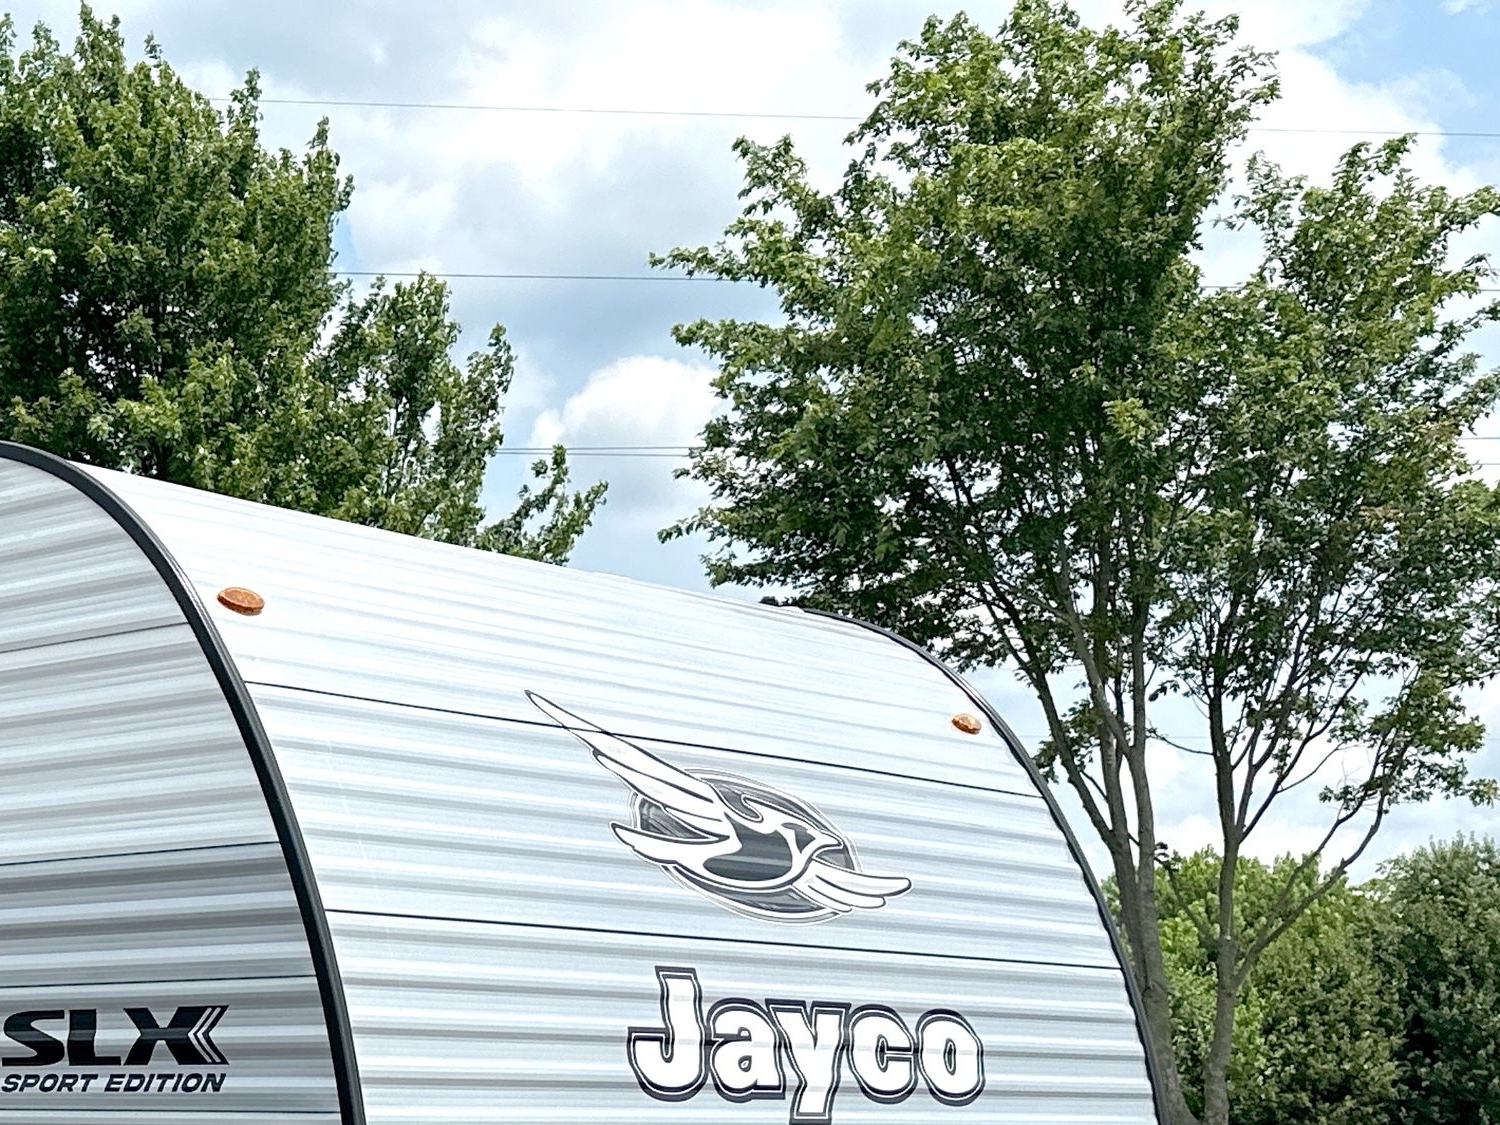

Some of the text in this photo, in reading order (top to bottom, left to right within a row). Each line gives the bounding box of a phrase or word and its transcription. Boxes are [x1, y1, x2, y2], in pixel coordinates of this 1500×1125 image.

[2, 1005, 230, 1067] SLX
[627, 965, 985, 1125] Jayco
[1, 1073, 227, 1093] SPORT EDITION
